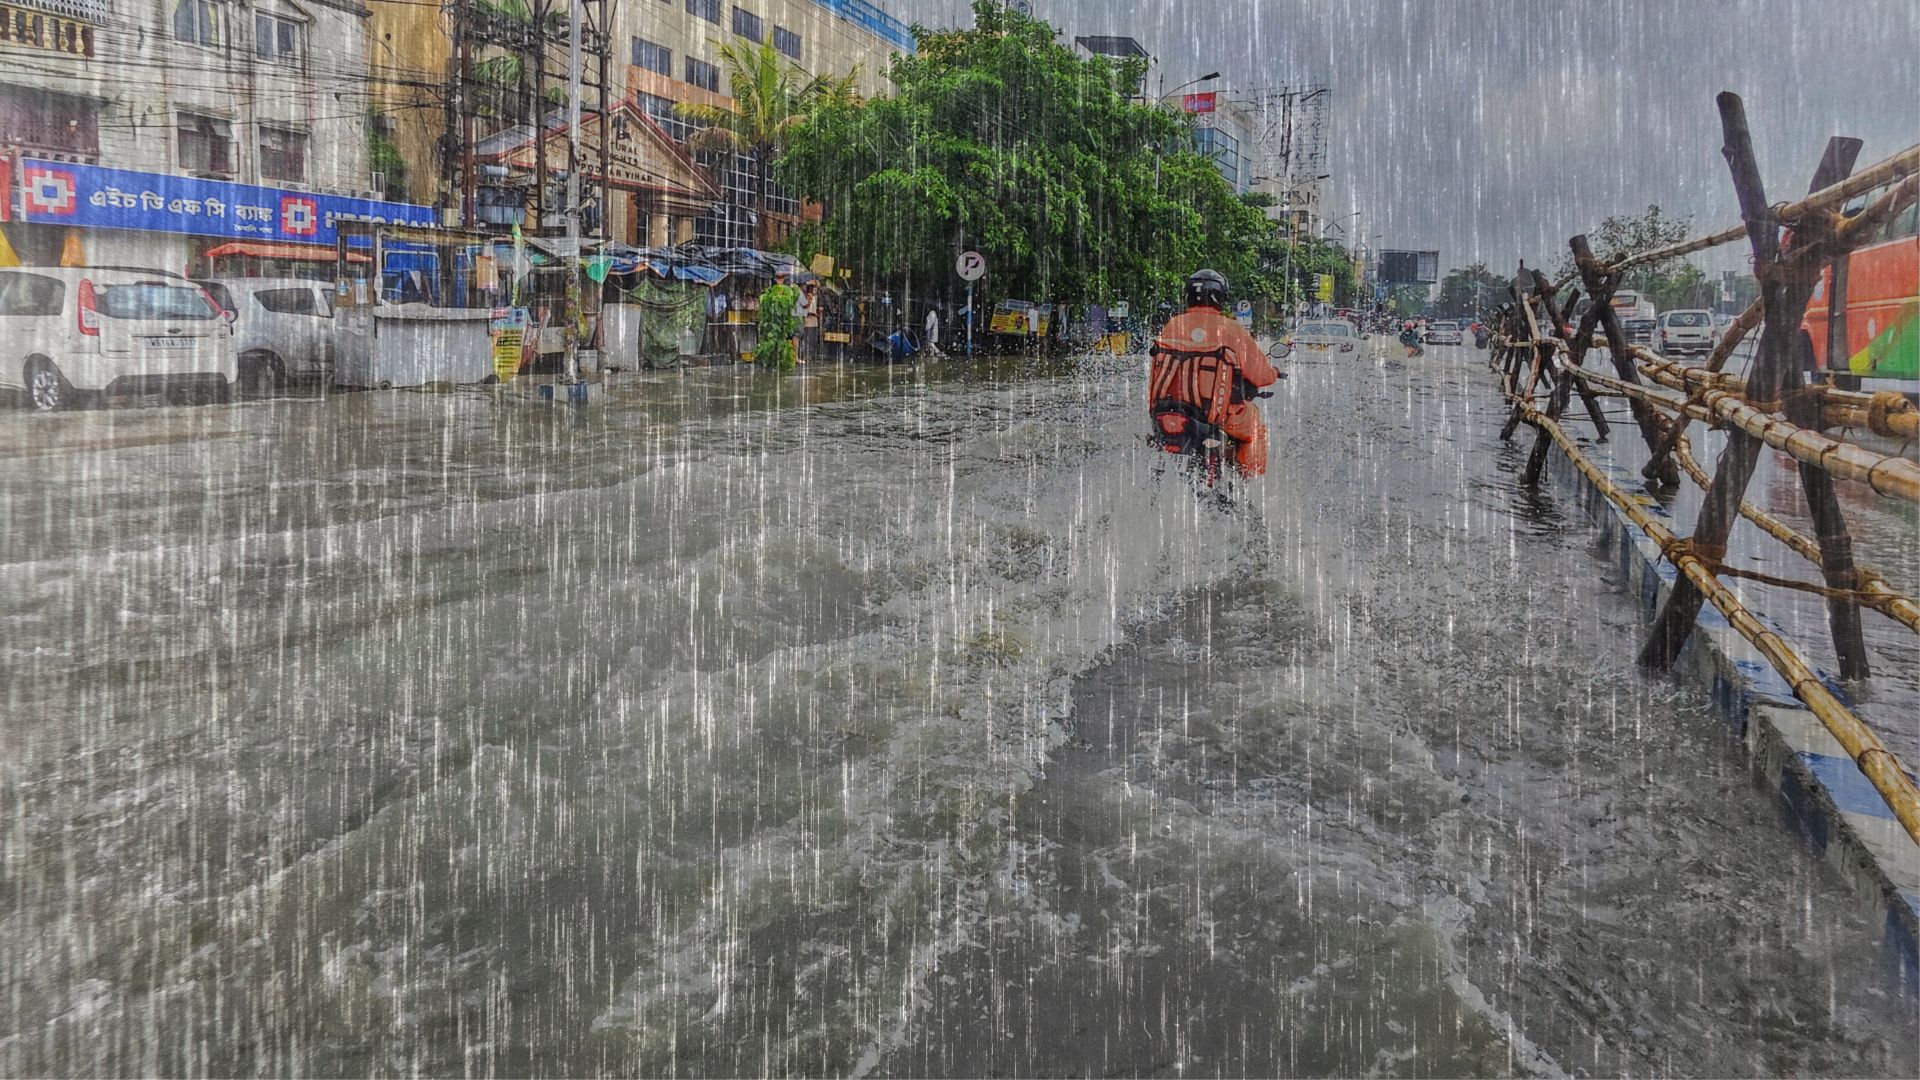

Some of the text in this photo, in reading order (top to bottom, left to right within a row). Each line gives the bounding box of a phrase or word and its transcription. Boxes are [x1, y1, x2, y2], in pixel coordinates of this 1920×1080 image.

[580, 163, 653, 183] PODAR VIHAR
[89, 185, 273, 222] এইচ ডি এফ সি ব্যাঙ্ক
